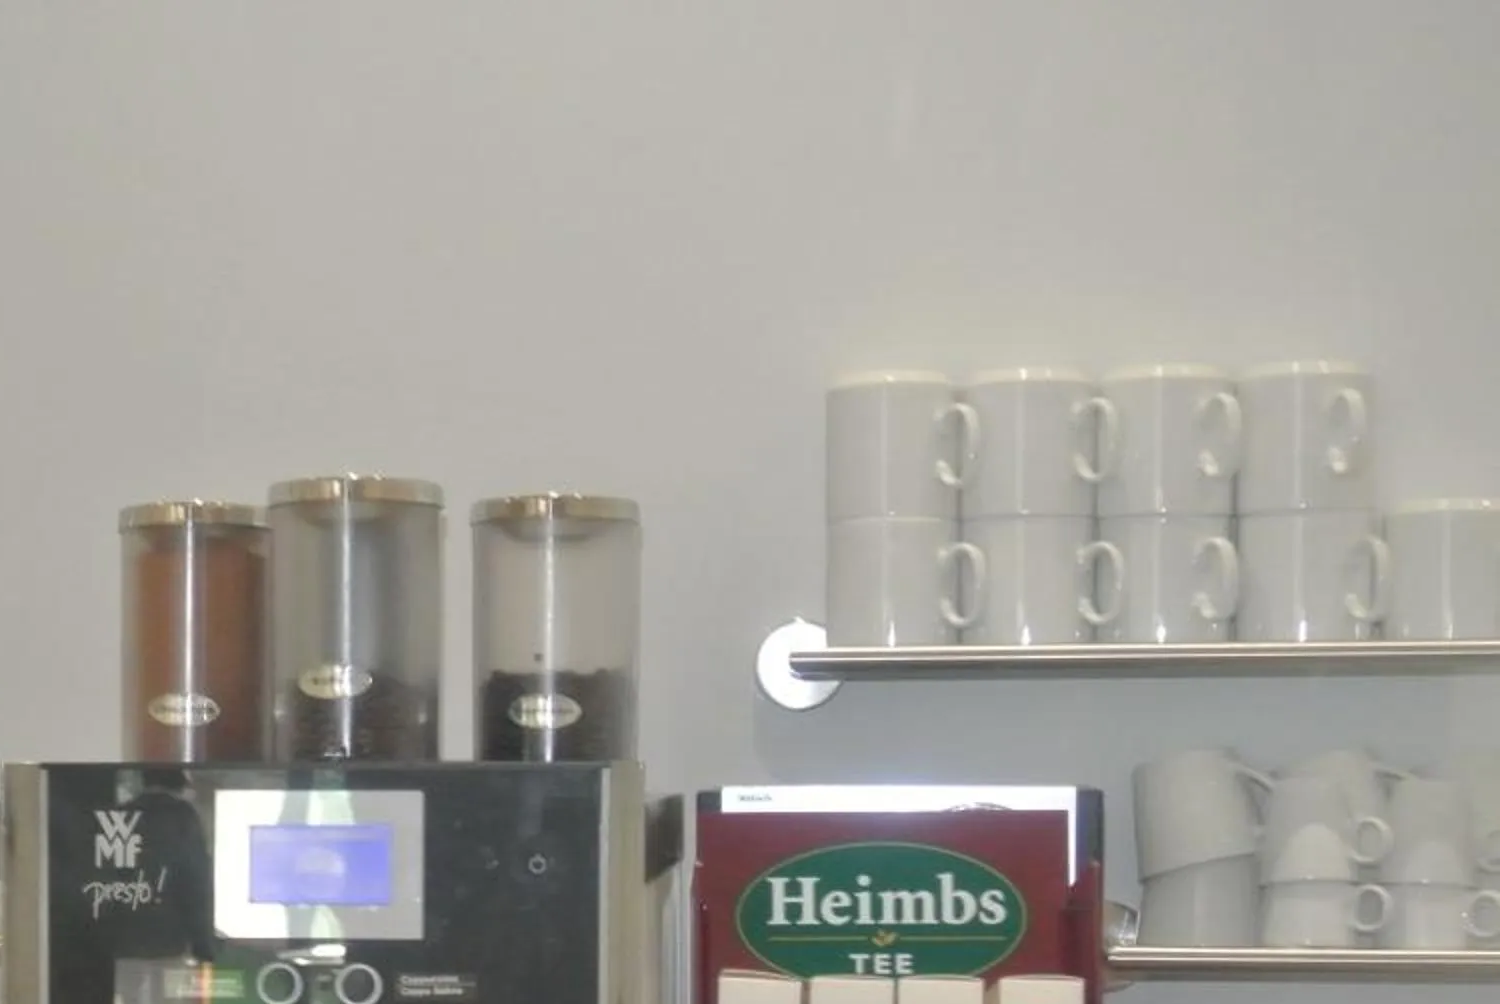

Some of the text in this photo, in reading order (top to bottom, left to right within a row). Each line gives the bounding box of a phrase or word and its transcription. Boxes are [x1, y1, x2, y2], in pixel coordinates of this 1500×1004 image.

[94, 809, 143, 869] WMF
[82, 866, 168, 920] presto!
[765, 872, 1008, 927] Heimbs
[848, 953, 915, 976] TEE
